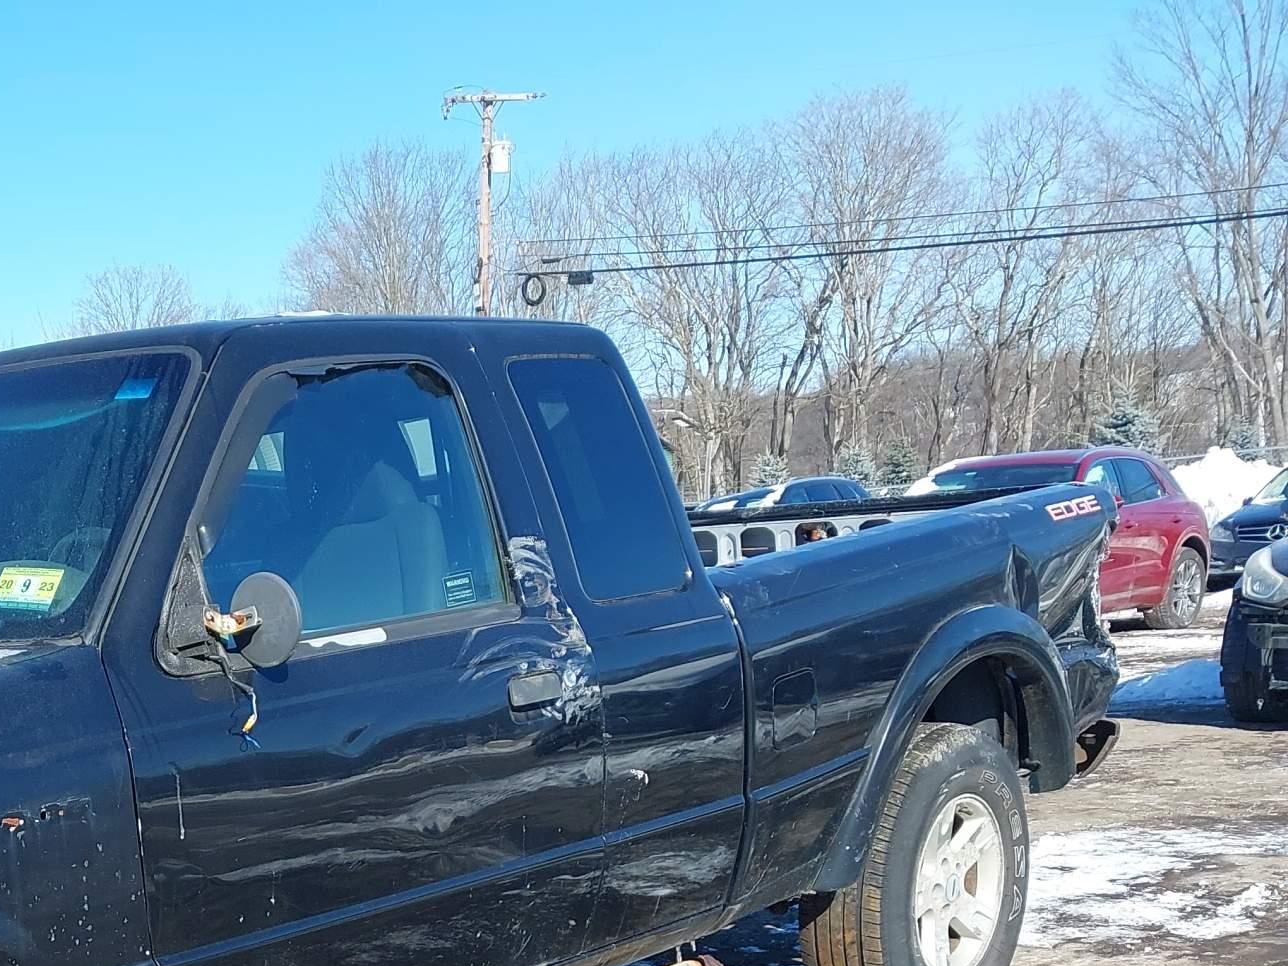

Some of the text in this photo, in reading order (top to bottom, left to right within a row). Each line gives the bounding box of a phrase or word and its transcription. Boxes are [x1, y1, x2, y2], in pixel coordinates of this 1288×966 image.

[1045, 495, 1102, 521] EDGE
[0, 578, 55, 593] 20 9 23
[978, 769, 1027, 922] PRESA
